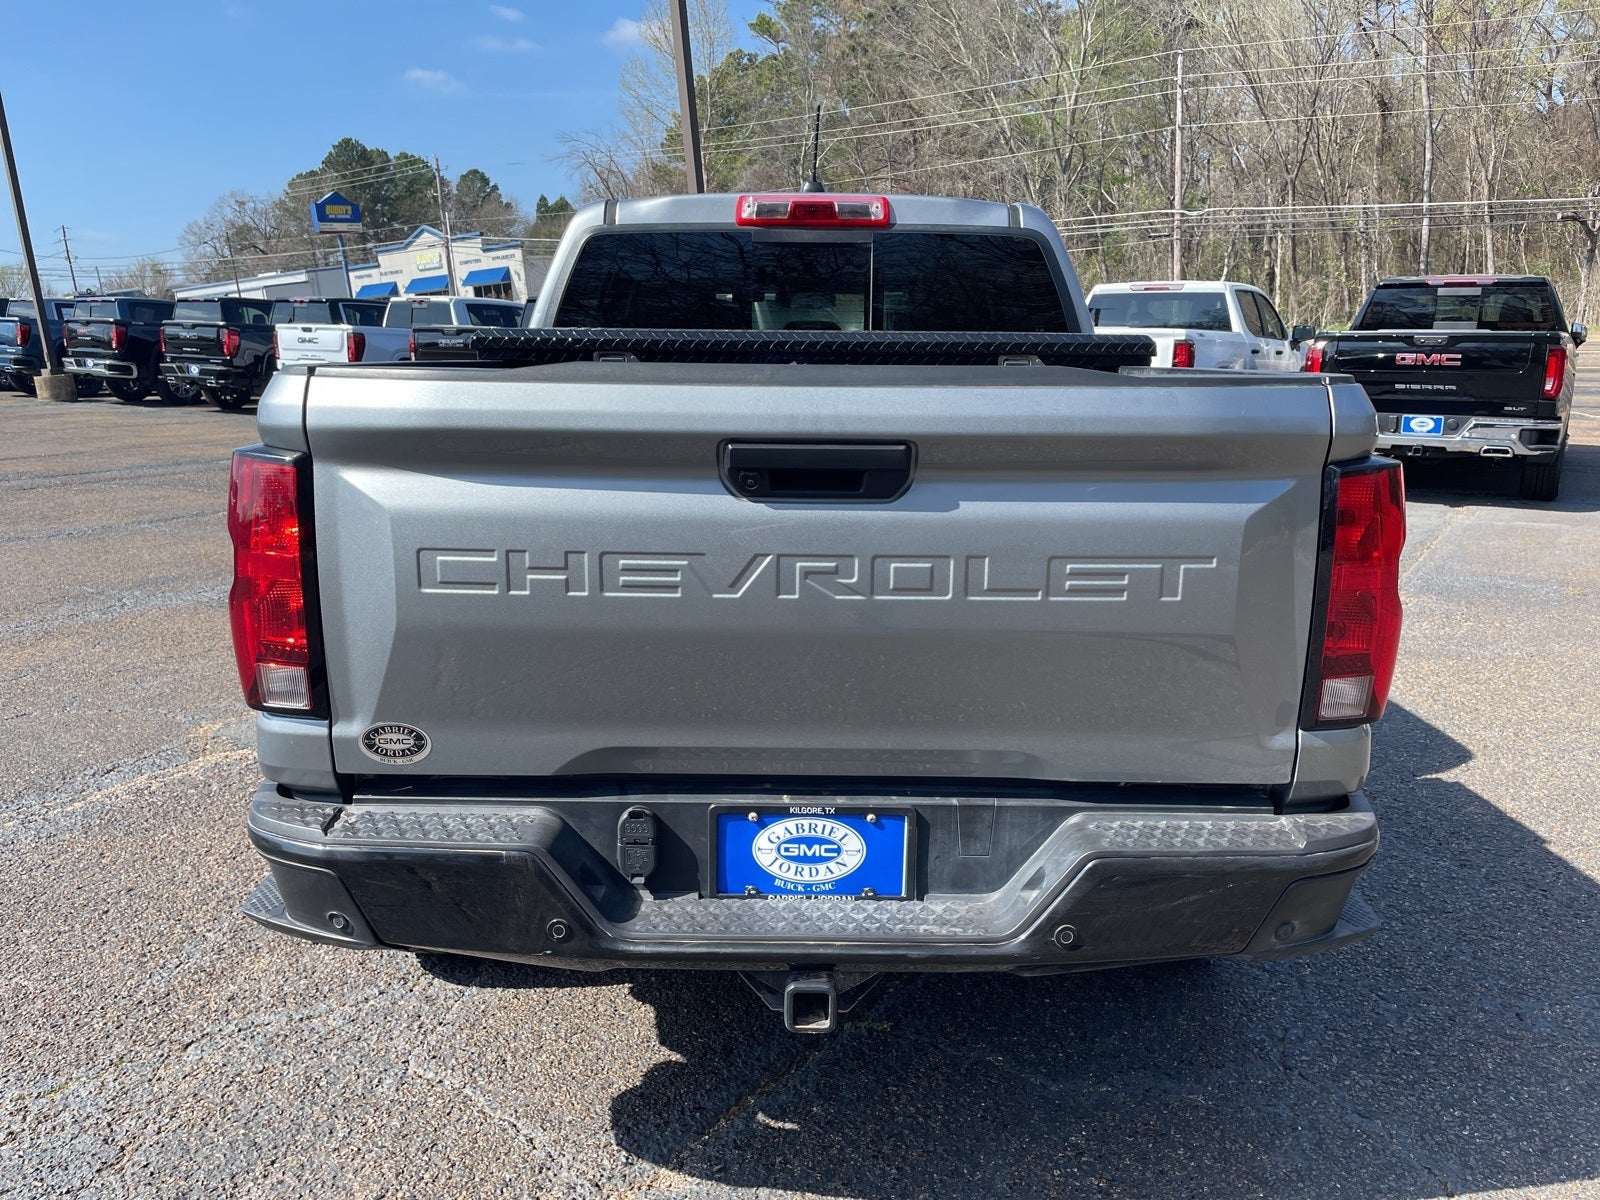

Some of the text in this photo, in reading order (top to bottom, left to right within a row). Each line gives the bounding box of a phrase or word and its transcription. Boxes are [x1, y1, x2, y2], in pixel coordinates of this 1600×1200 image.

[297, 336, 319, 344] GMC
[1395, 352, 1462, 366] GMC
[1394, 383, 1457, 391] SIERRA
[417, 547, 1218, 602] CHEVROLET
[369, 726, 417, 740] GABRIEL
[378, 737, 412, 745] GMC
[371, 745, 419, 757] JORDAN
[767, 822, 850, 847] GABRIEL
[780, 843, 838, 857] GMC
[767, 857, 849, 879] JORDAN
[773, 878, 805, 892] BUICK
[812, 882, 836, 892] GMC
